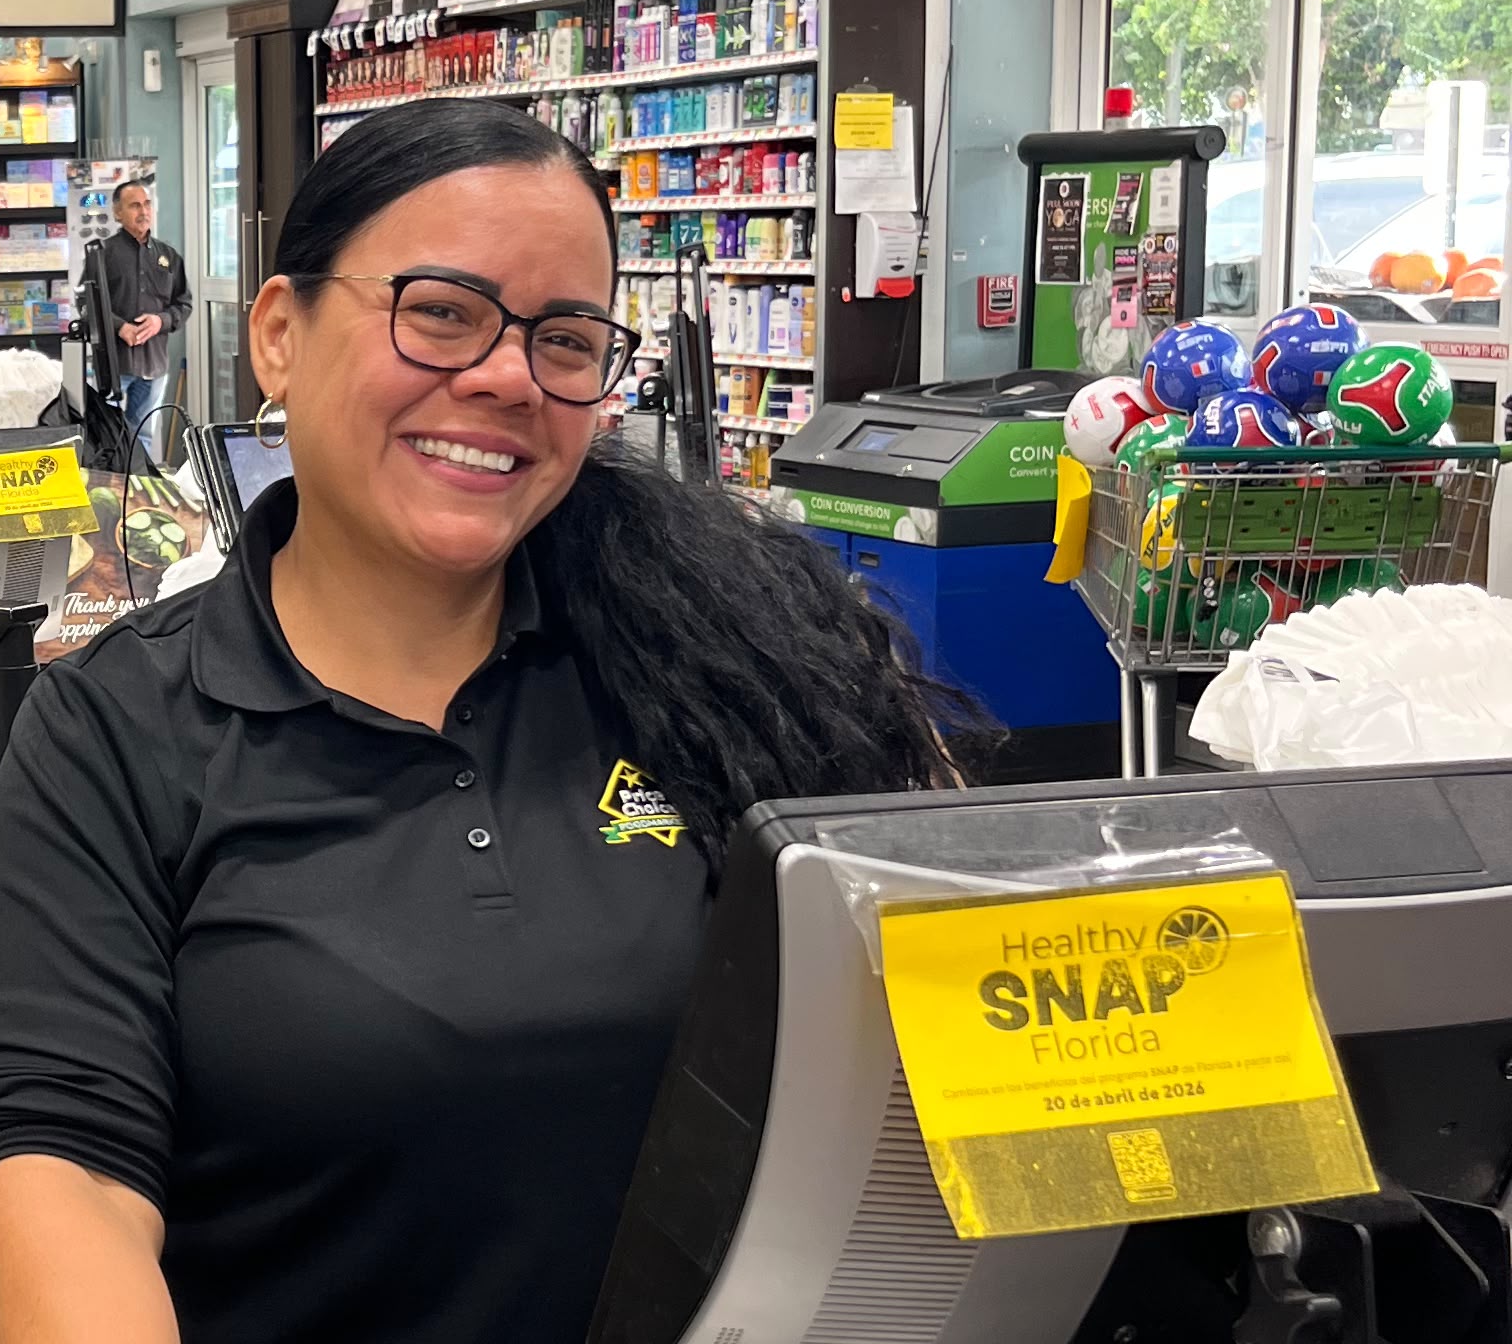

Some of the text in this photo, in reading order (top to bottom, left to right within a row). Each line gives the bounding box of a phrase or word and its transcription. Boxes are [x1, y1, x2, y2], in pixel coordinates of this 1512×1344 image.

[988, 276, 1015, 288] FIRE
[1310, 340, 1349, 354] ESPN
[1009, 445, 1054, 462] COIN
[810, 496, 891, 520] COIN CONVERSION
[64, 592, 115, 616] Thank
[619, 788, 666, 804] Price
[1001, 921, 1149, 964] Healthy
[979, 953, 1186, 1031] SNAP
[1029, 1025, 1162, 1065] Florida
[1150, 1065, 1179, 1078] SNAP
[1044, 1081, 1206, 1112] 20 de abril de 2026
